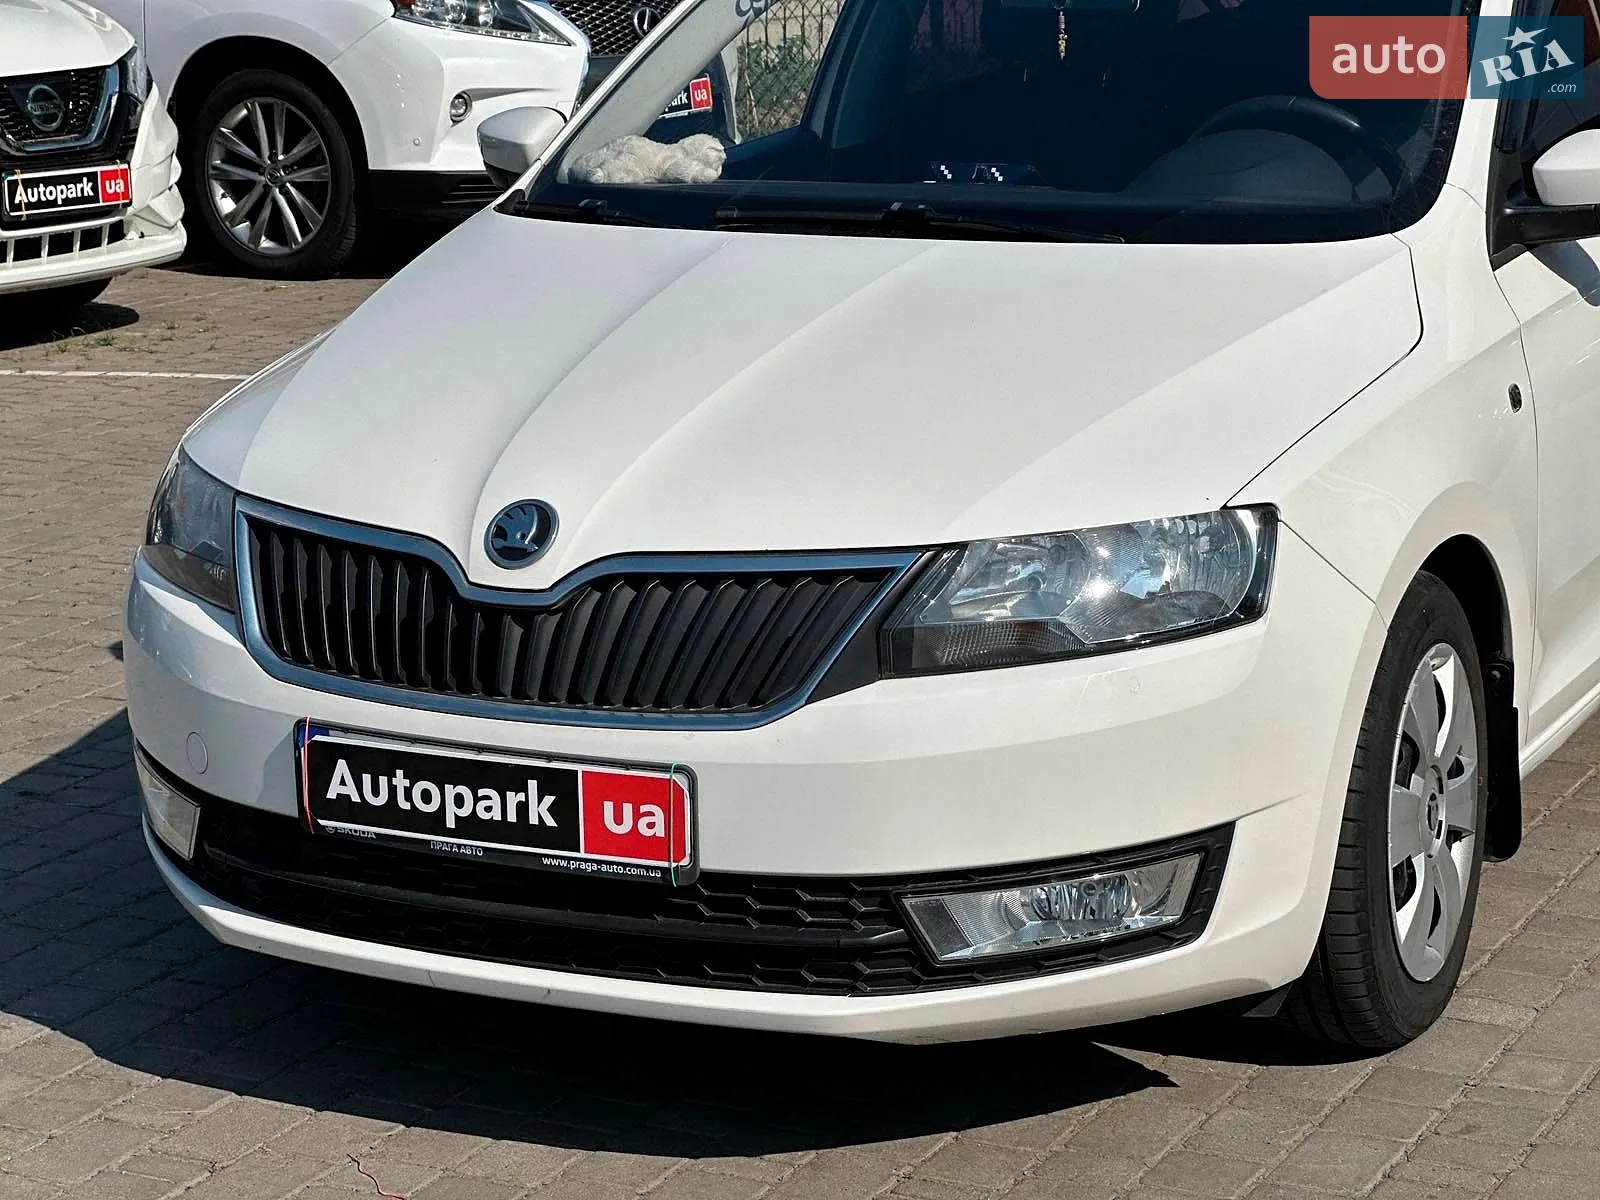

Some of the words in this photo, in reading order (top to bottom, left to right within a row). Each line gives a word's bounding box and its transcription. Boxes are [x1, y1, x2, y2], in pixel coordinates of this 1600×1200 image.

[694, 88, 708, 102] ua
[14, 176, 94, 204] Autopark
[105, 178, 125, 194] ua
[325, 758, 558, 828] Autopark
[602, 798, 666, 838] ua
[430, 840, 459, 853] ПРАГА
[460, 845, 483, 856] АВТО
[542, 856, 662, 878] www.praga-auto.com.ua
